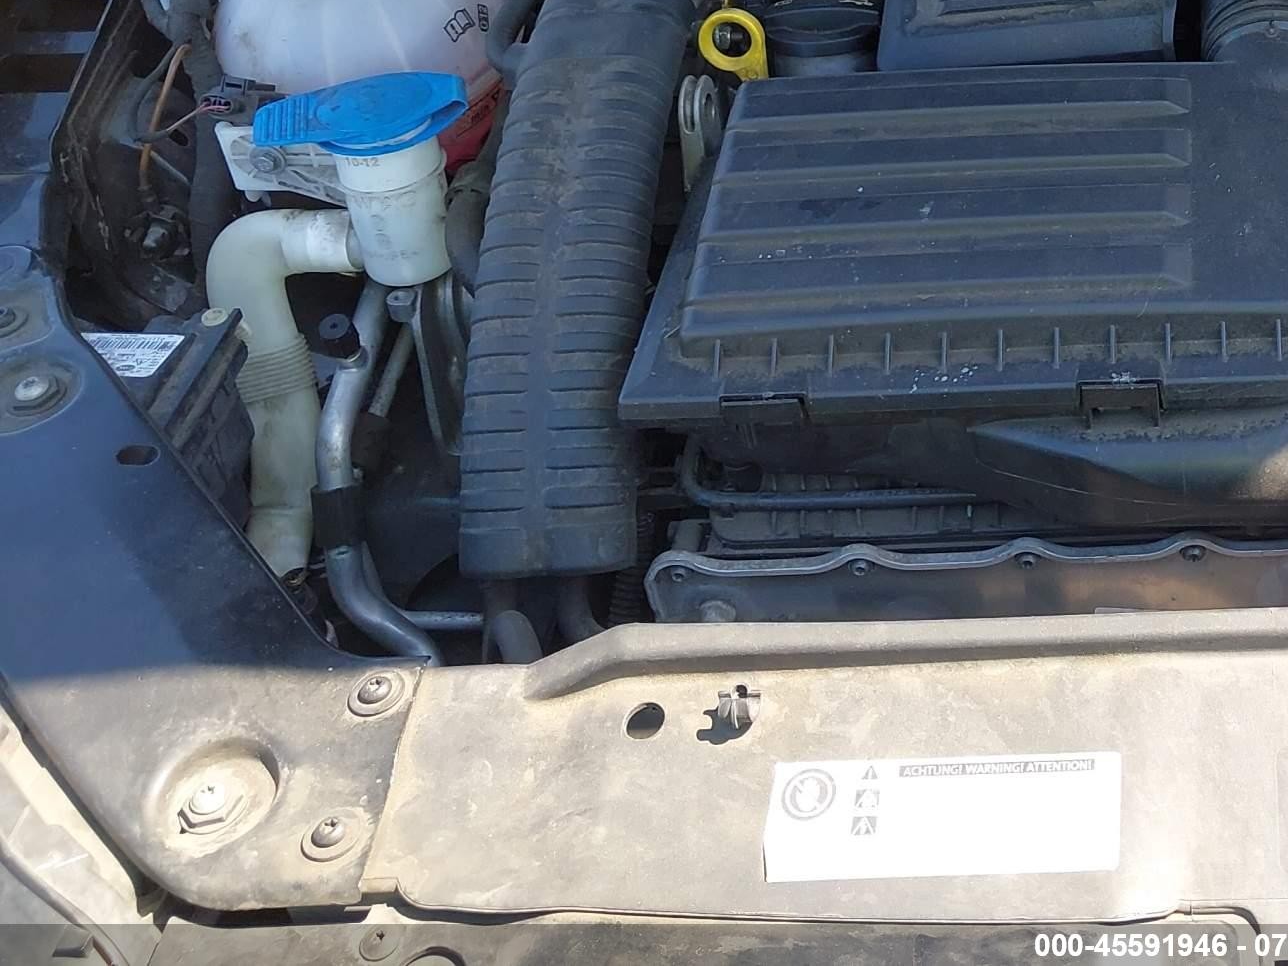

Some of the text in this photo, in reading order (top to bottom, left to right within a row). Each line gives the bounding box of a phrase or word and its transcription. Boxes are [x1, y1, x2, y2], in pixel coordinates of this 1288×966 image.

[902, 758, 1093, 777] ACHTUNG! WARNING! ATTENTION!
